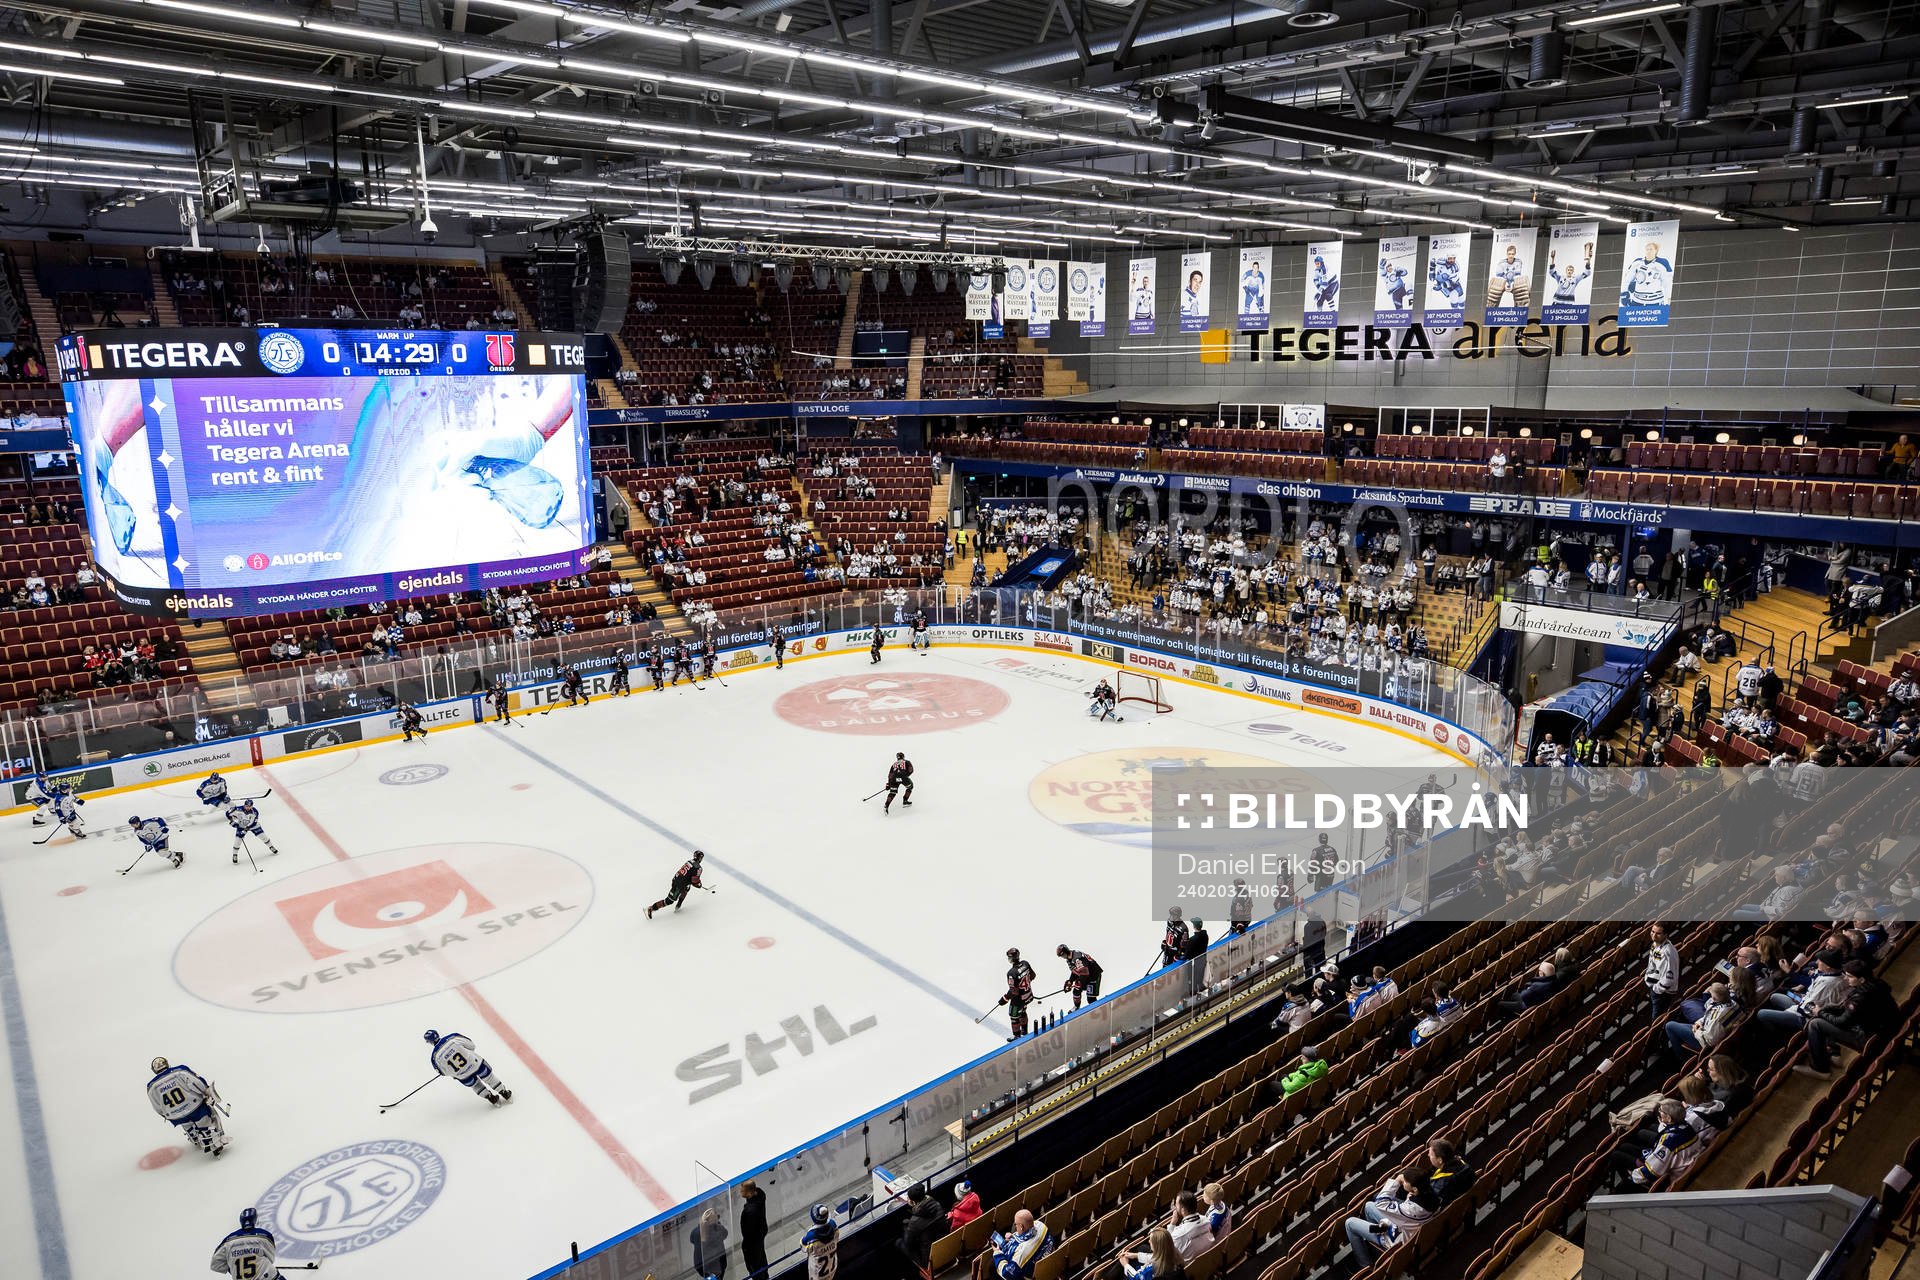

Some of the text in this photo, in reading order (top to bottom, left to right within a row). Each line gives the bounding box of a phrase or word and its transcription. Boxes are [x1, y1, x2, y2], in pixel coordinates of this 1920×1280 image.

[1554, 230, 1560, 238] 6
[1631, 229, 1637, 237] 8
[1309, 247, 1317, 255] 15
[1381, 243, 1391, 252] 18
[1432, 240, 1438, 249] 2
[1184, 258, 1189, 266] 2
[1242, 253, 1248, 261] 3
[1131, 263, 1140, 271] 22
[377, 332, 415, 340] WARM UP
[1454, 314, 1632, 361] arena
[323, 343, 340, 363] 0
[362, 343, 434, 364] 14:29
[452, 343, 467, 363] 0
[378, 368, 412, 376] PERIOD
[200, 395, 344, 414] Tillsammans
[798, 404, 850, 414] BASTULOGE
[205, 418, 294, 438] håller vi
[207, 440, 350, 465] Tegera Arena
[211, 463, 324, 486] rent & fint
[1256, 481, 1321, 499] clas ohlson
[1353, 488, 1445, 507] Leksands Sparbank
[1485, 498, 1557, 517] PEAB
[271, 550, 343, 567] AllOffice
[482, 561, 571, 579] SKYDDAR HÄNDER OCH FÖTTER
[399, 571, 464, 593] ejendals
[165, 594, 234, 613] ejendals
[258, 585, 378, 604] SKYDDAR HÄNDER OCH FÖTTER
[1505, 605, 1612, 640] Tandvårdsteam
[846, 630, 898, 643] HiKKI
[972, 629, 1024, 641] OPTILEKS
[1034, 631, 1073, 646] S.K.M.A.
[573, 651, 637, 672] entrémaor
[717, 636, 729, 646] till
[731, 630, 764, 646] företag
[766, 627, 774, 637] &
[779, 619, 822, 639] öreningar
[1106, 629, 1116, 637] av
[1117, 628, 1165, 646] entrémattor
[1167, 639, 1183, 650] och
[1185, 640, 1235, 660] logomattor
[1237, 652, 1250, 664] till
[1251, 655, 1289, 674] företag
[1291, 662, 1300, 674] &
[1303, 664, 1359, 687] föreningar
[1129, 652, 1176, 673] BORGA
[1742, 677, 1756, 688] 28
[1256, 684, 1291, 701] FÄLTMANS
[819, 708, 986, 729] BAUHAUS
[1369, 705, 1427, 733] DALA-GRIPEN
[1291, 732, 1348, 753] Telia
[167, 758, 193, 770] ŠKODA
[251, 899, 580, 1005] SVENSKA SPEL
[447, 1052, 468, 1073] 13
[675, 1004, 878, 1105] SHL
[162, 1087, 186, 1108] 40
[310, 1199, 429, 1258] ISHOCKEY
[234, 1255, 257, 1280] 15
